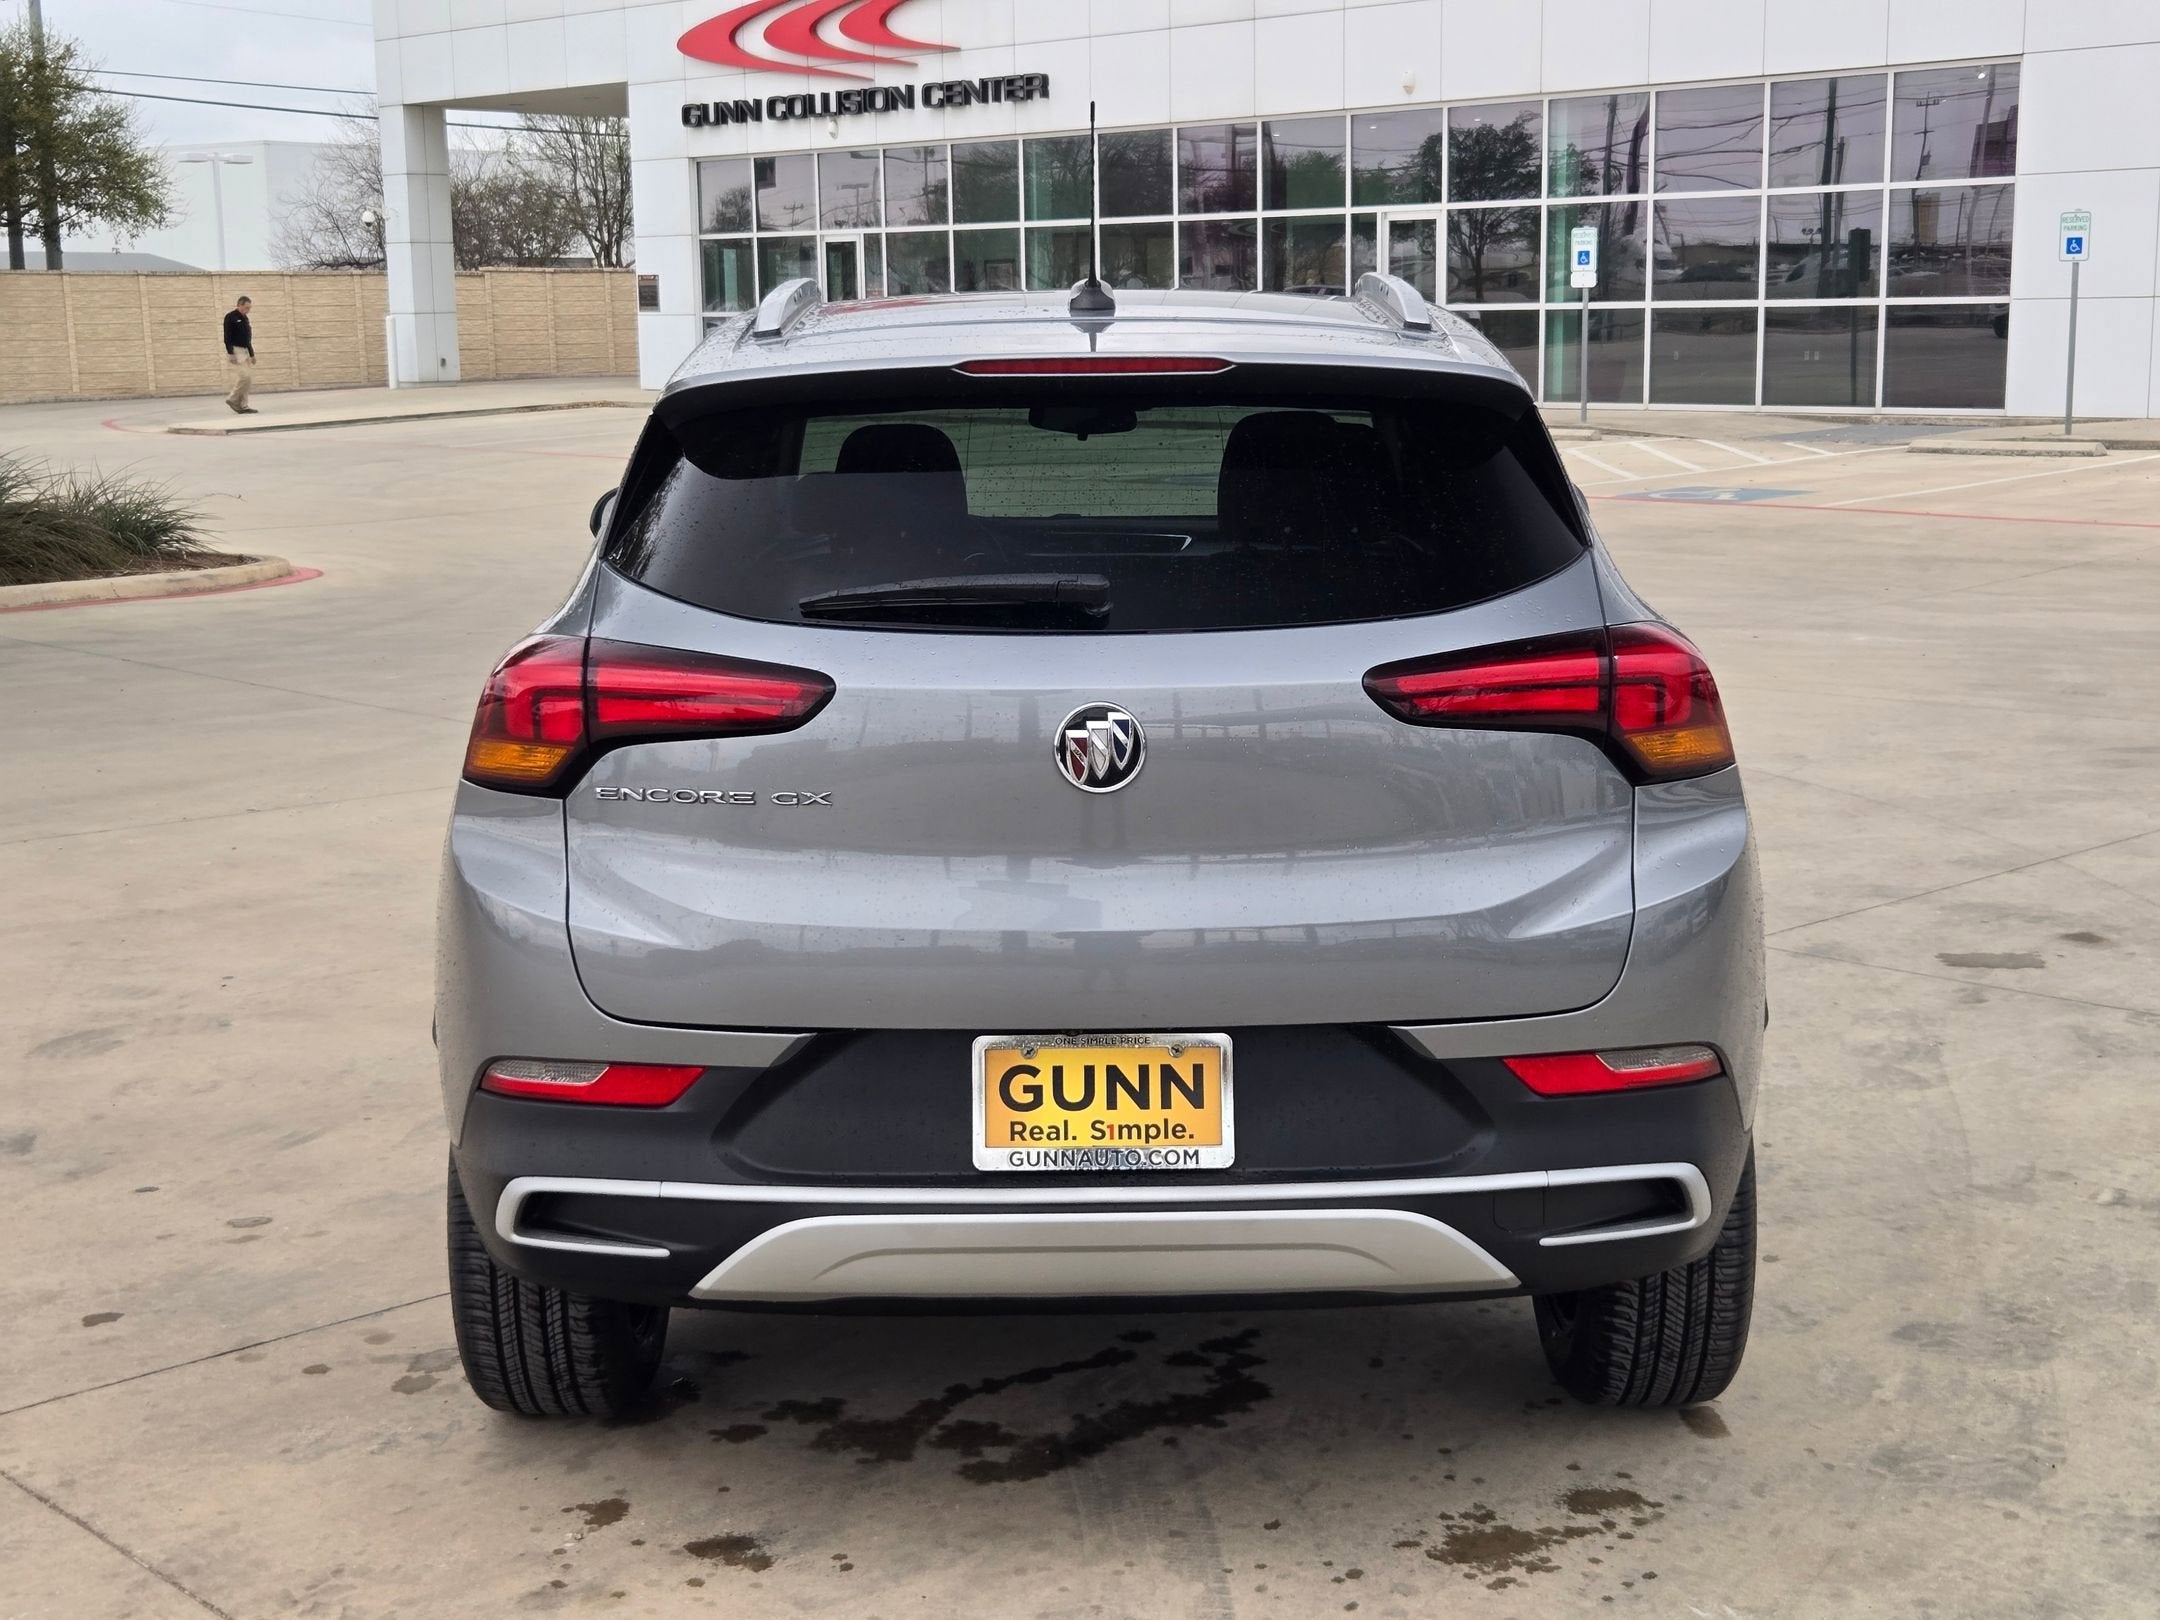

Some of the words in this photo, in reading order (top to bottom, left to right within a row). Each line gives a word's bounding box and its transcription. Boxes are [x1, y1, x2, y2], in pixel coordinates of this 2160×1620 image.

[682, 98, 762, 127] GUNN
[766, 84, 915, 120] COLLISION
[921, 73, 1049, 108] CENTER
[596, 786, 755, 805] ENCORE
[770, 790, 832, 807] GX
[1055, 1037, 1077, 1046] ONE
[1081, 1037, 1117, 1046] SIMPLE
[1120, 1036, 1150, 1045] PRICE
[999, 1063, 1204, 1112] GUNN
[1010, 1120, 1077, 1142] Real.
[1009, 1149, 1200, 1167] GUNNAUTO.COM
